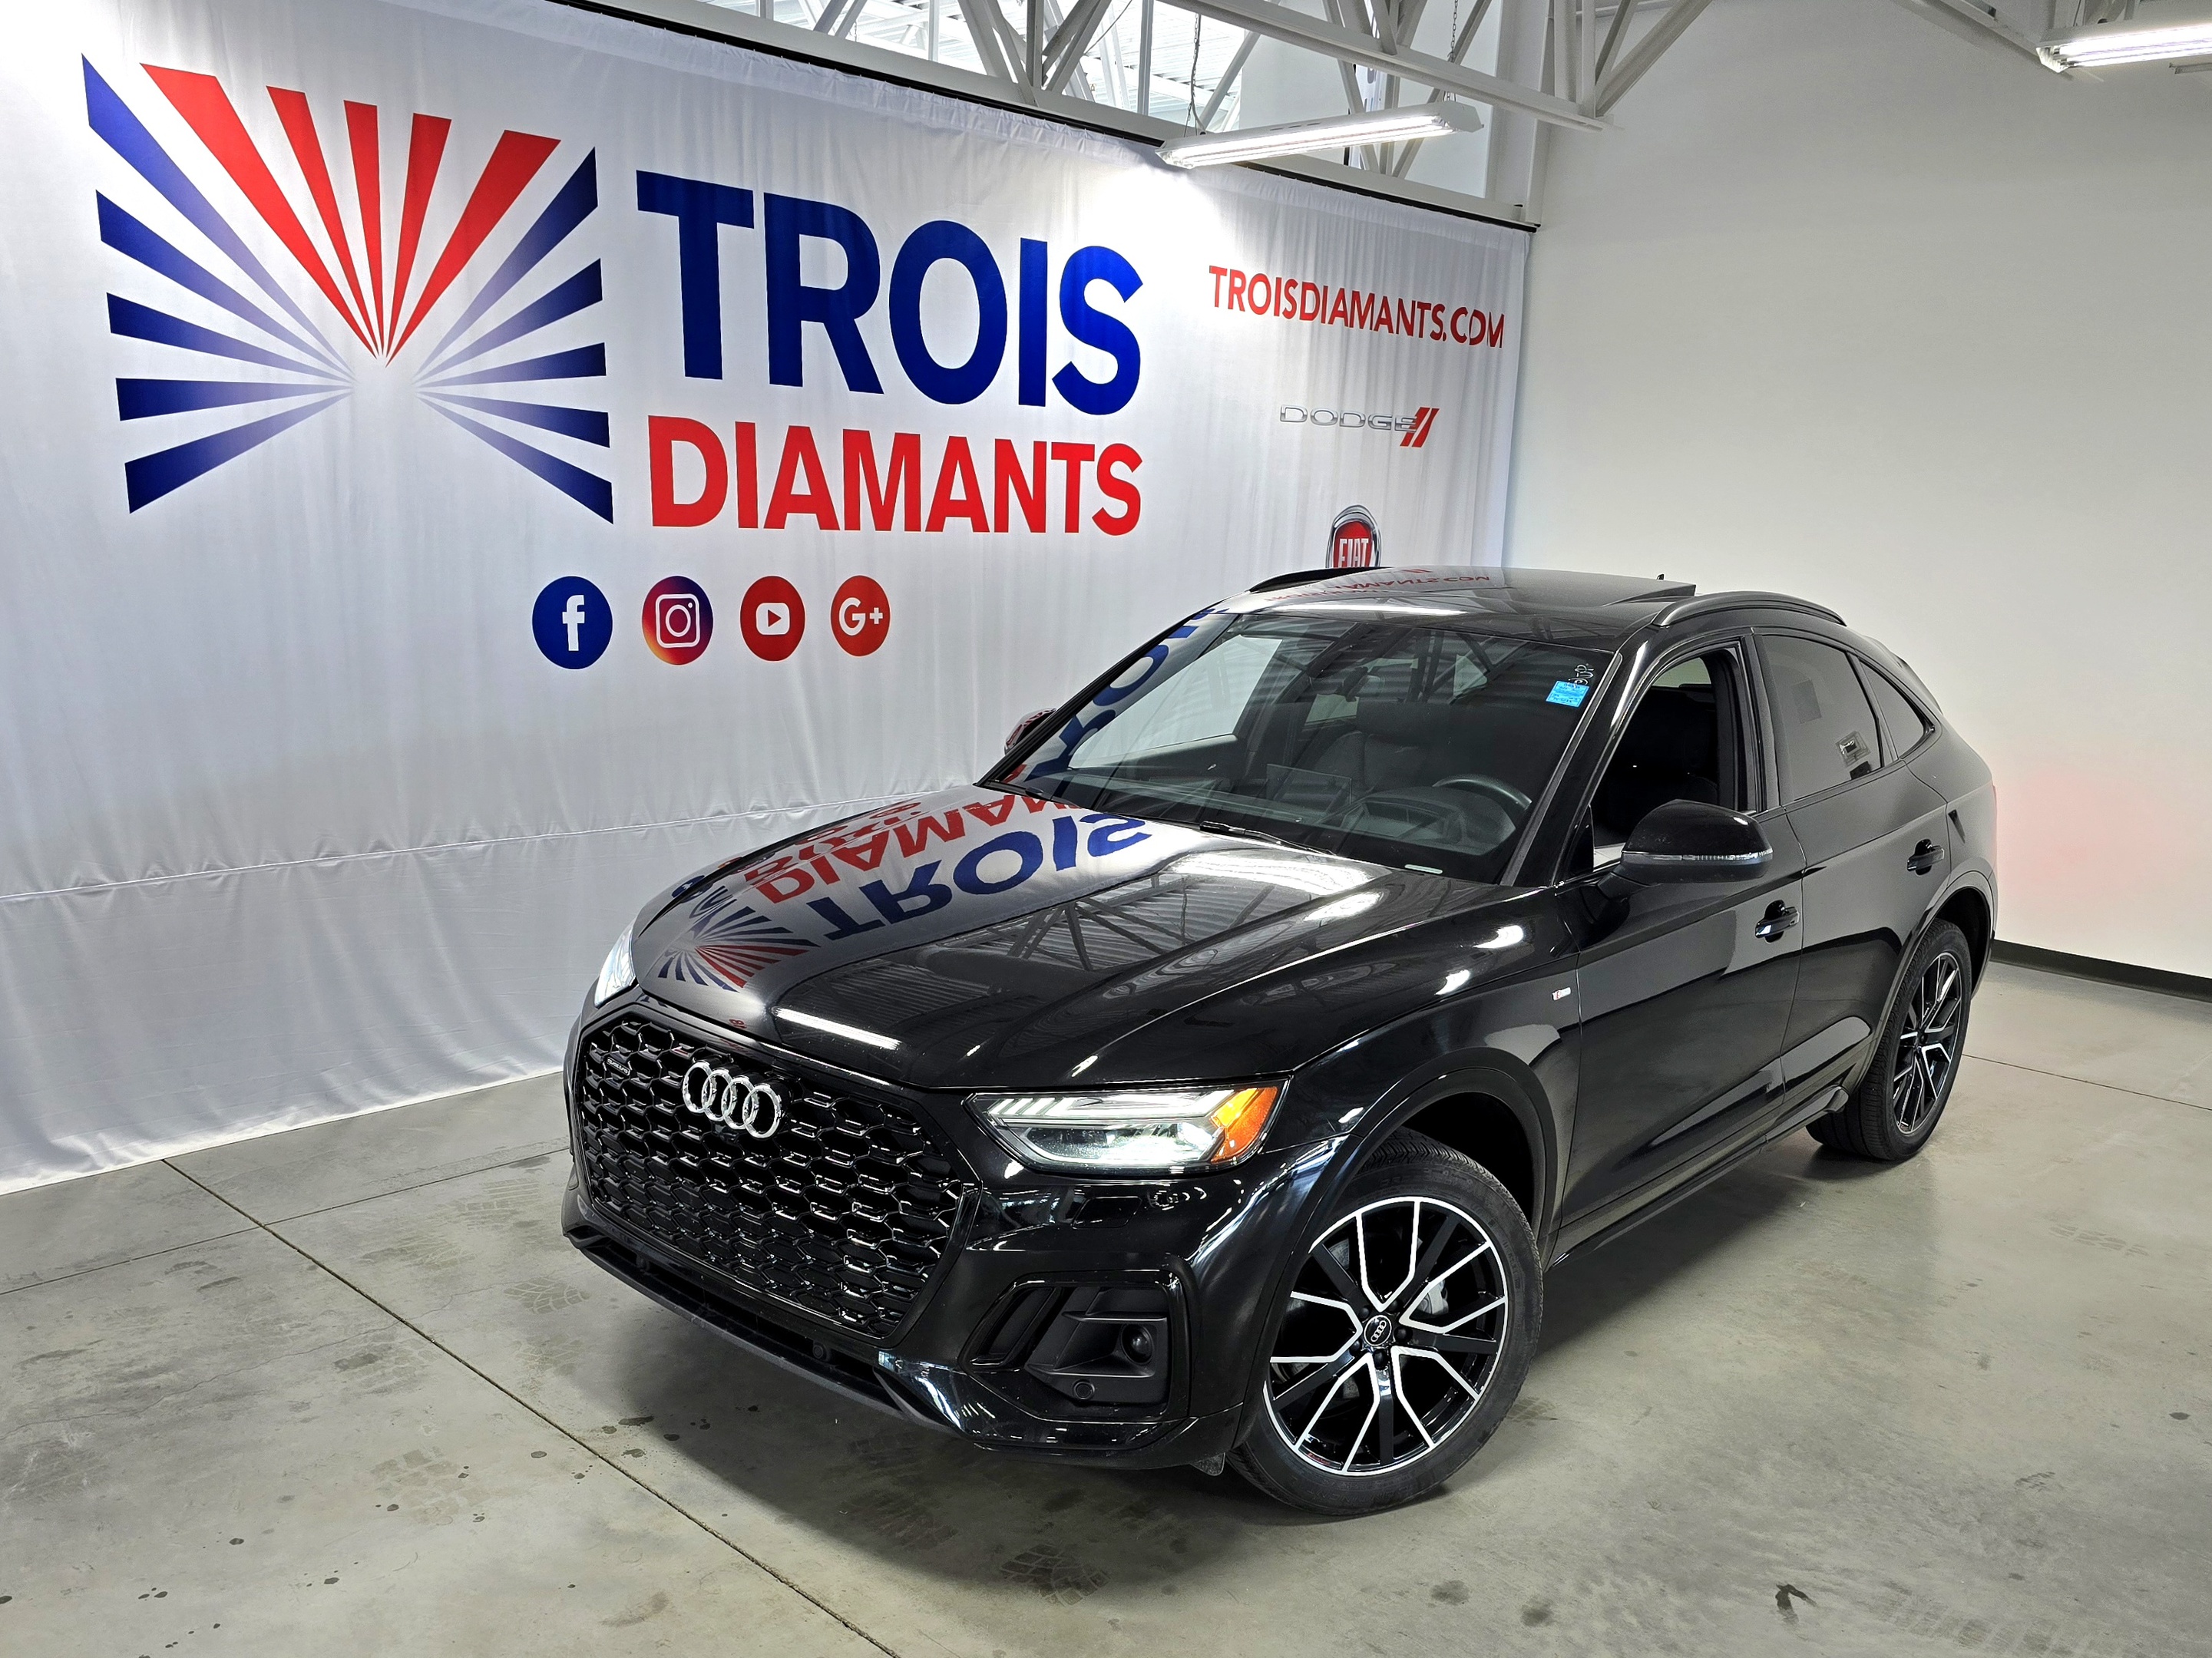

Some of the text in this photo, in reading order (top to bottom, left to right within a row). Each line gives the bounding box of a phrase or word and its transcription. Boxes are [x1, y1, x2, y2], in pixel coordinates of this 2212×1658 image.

[636, 170, 1143, 415] TROIS
[1208, 265, 1505, 348] TROISDIAMANTS.COM
[1280, 405, 1417, 433] DODGE
[648, 414, 1143, 536] DIAMANTS
[1337, 538, 1369, 568] FIAT
